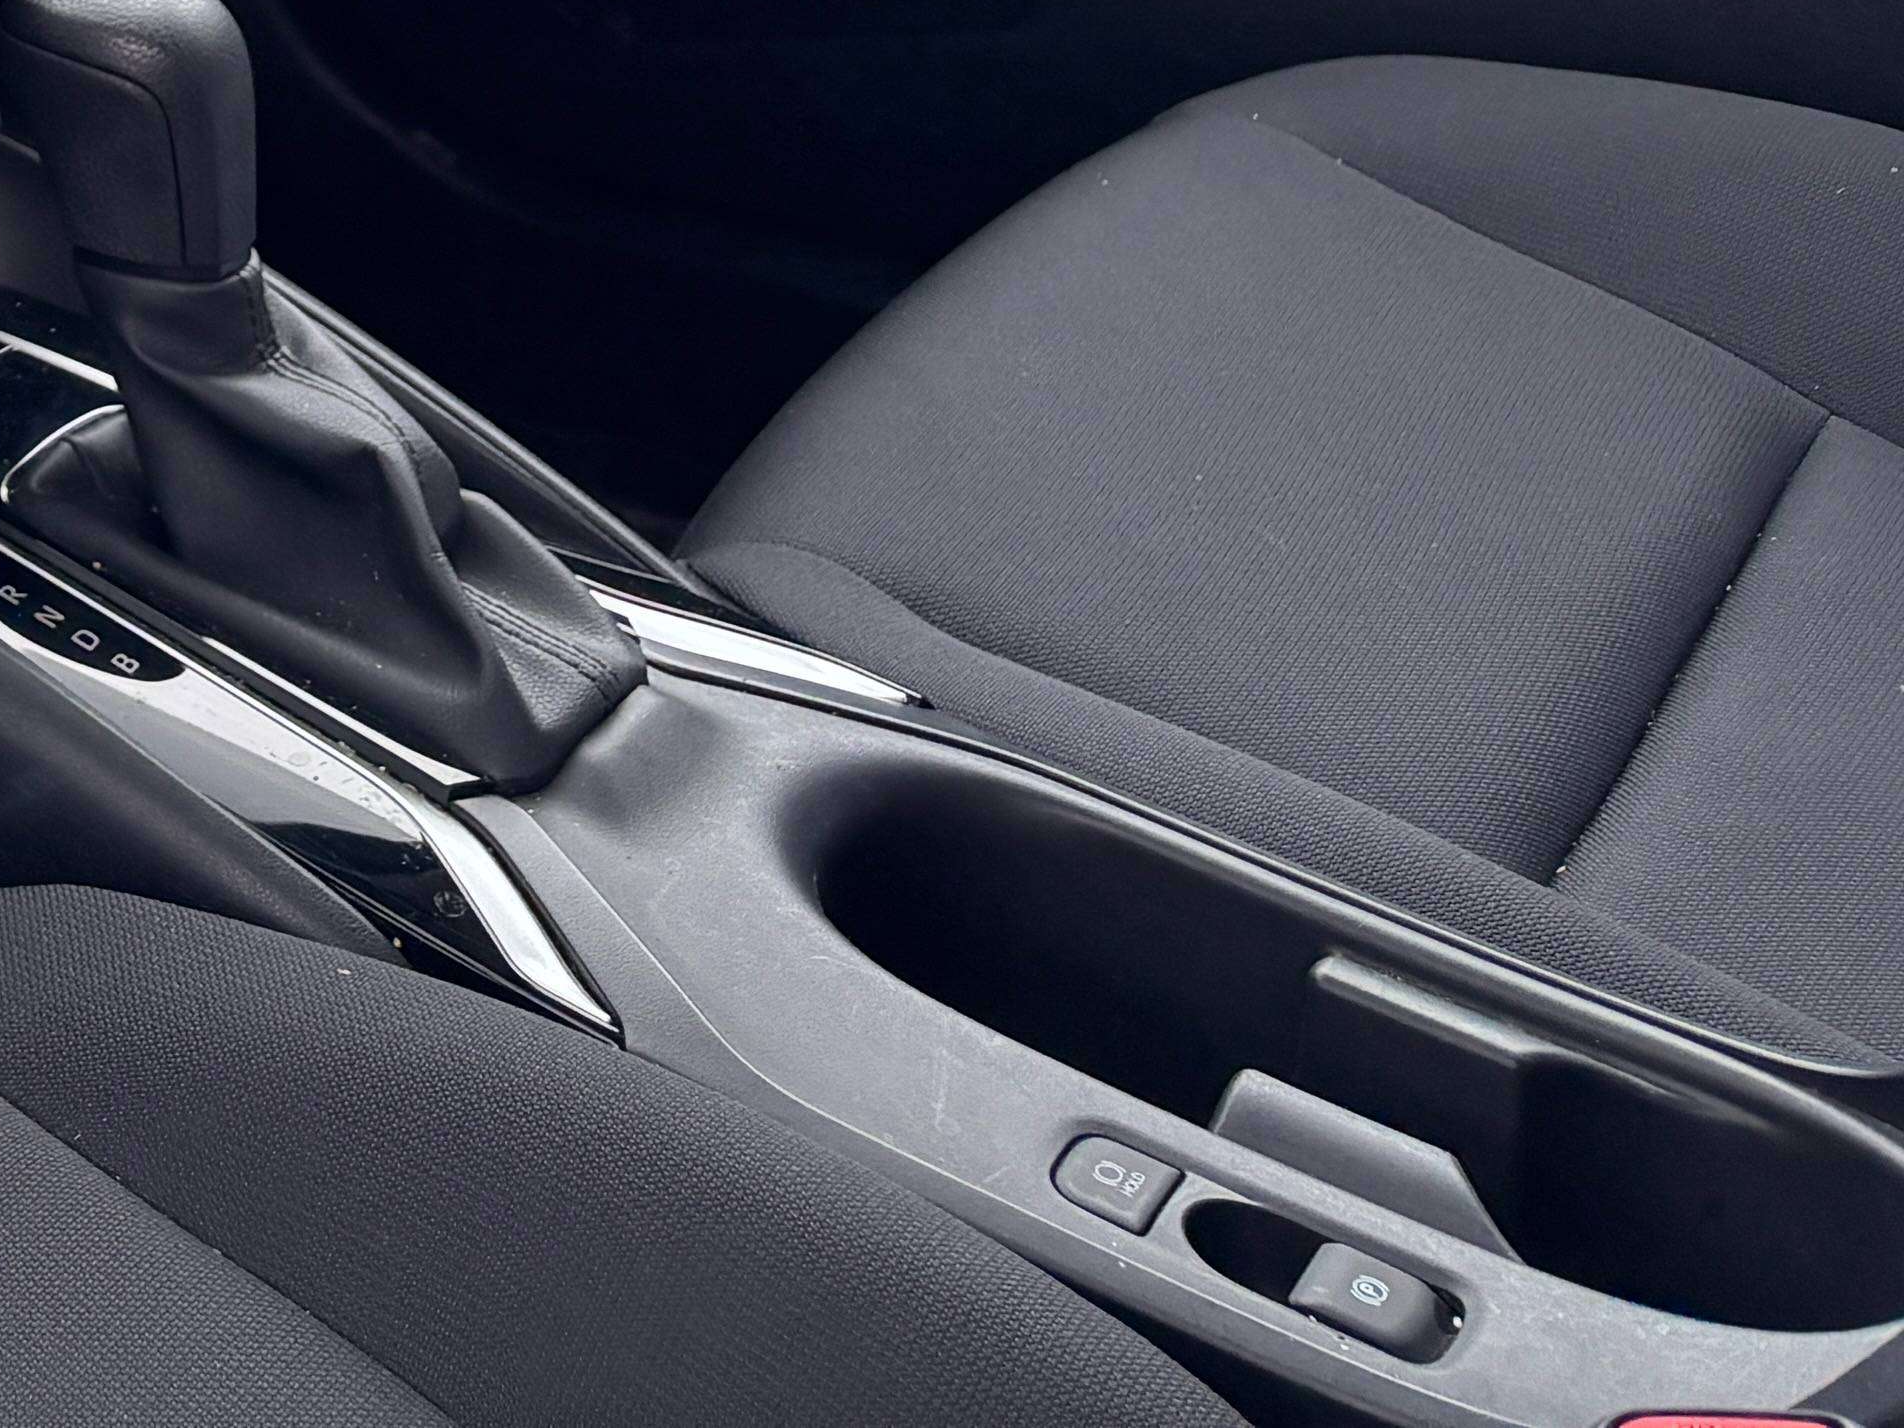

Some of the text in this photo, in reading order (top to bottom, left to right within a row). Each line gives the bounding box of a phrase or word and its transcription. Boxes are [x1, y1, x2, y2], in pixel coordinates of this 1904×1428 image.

[33, 604, 66, 629] N
[70, 629, 101, 652] D
[110, 653, 140, 675] B
[1119, 1171, 1146, 1198] HOLD
